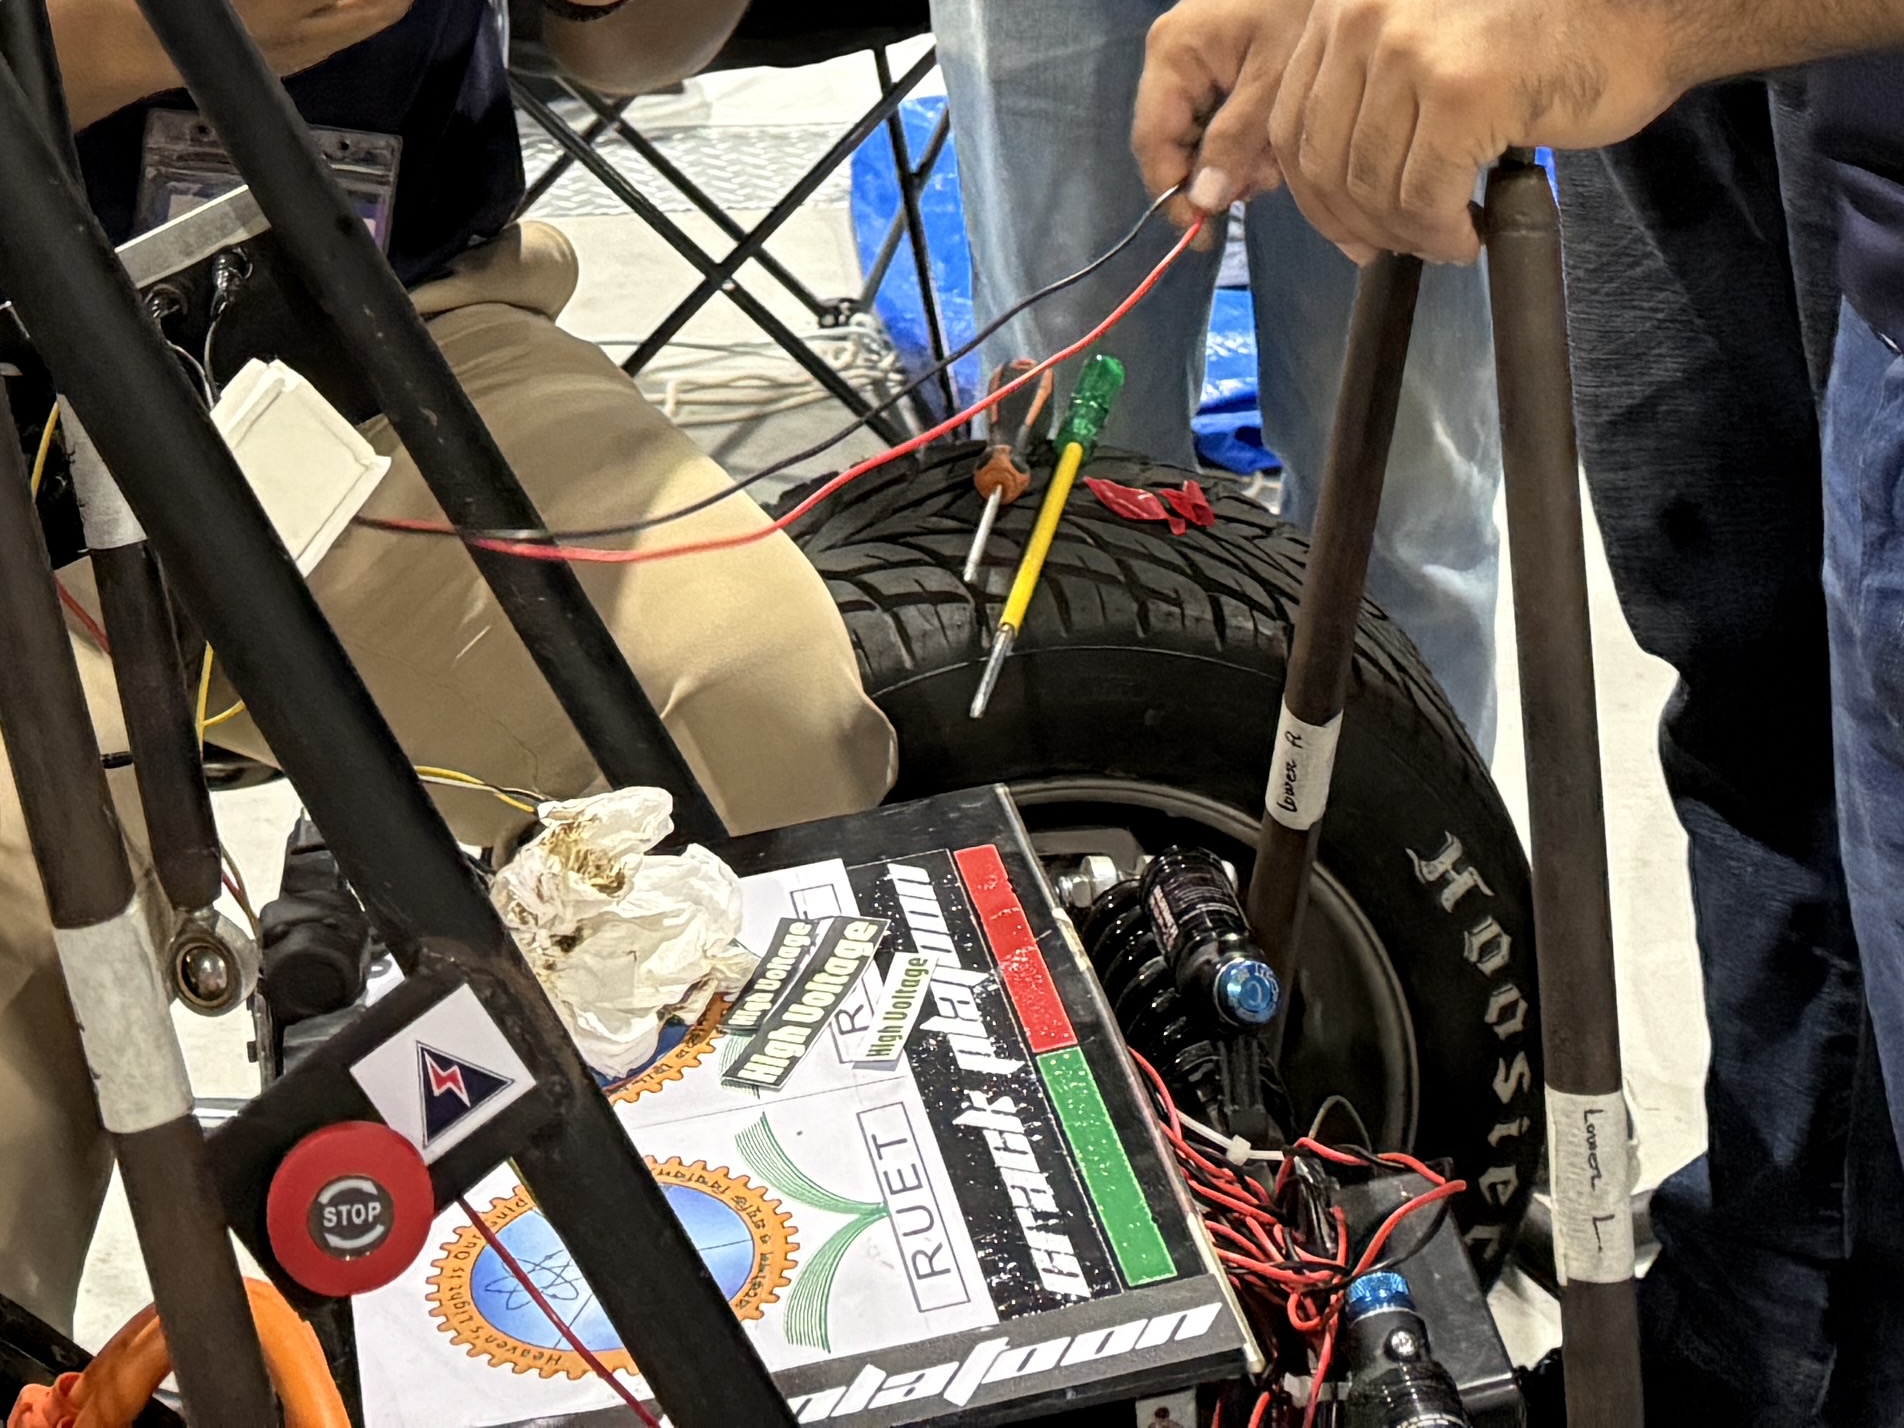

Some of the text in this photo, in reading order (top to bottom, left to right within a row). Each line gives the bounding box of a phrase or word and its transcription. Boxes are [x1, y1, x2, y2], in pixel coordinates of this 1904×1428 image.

[737, 1025, 812, 1084] High
[782, 920, 879, 1024] Voltage
[865, 957, 930, 1057] High Voltage
[1405, 830, 1532, 1261] Hoosier
[322, 1201, 382, 1228] STOP
[871, 1133, 952, 1282] RUET
[448, 1286, 473, 1325] Light
[471, 1325, 563, 1366] Heaven's
